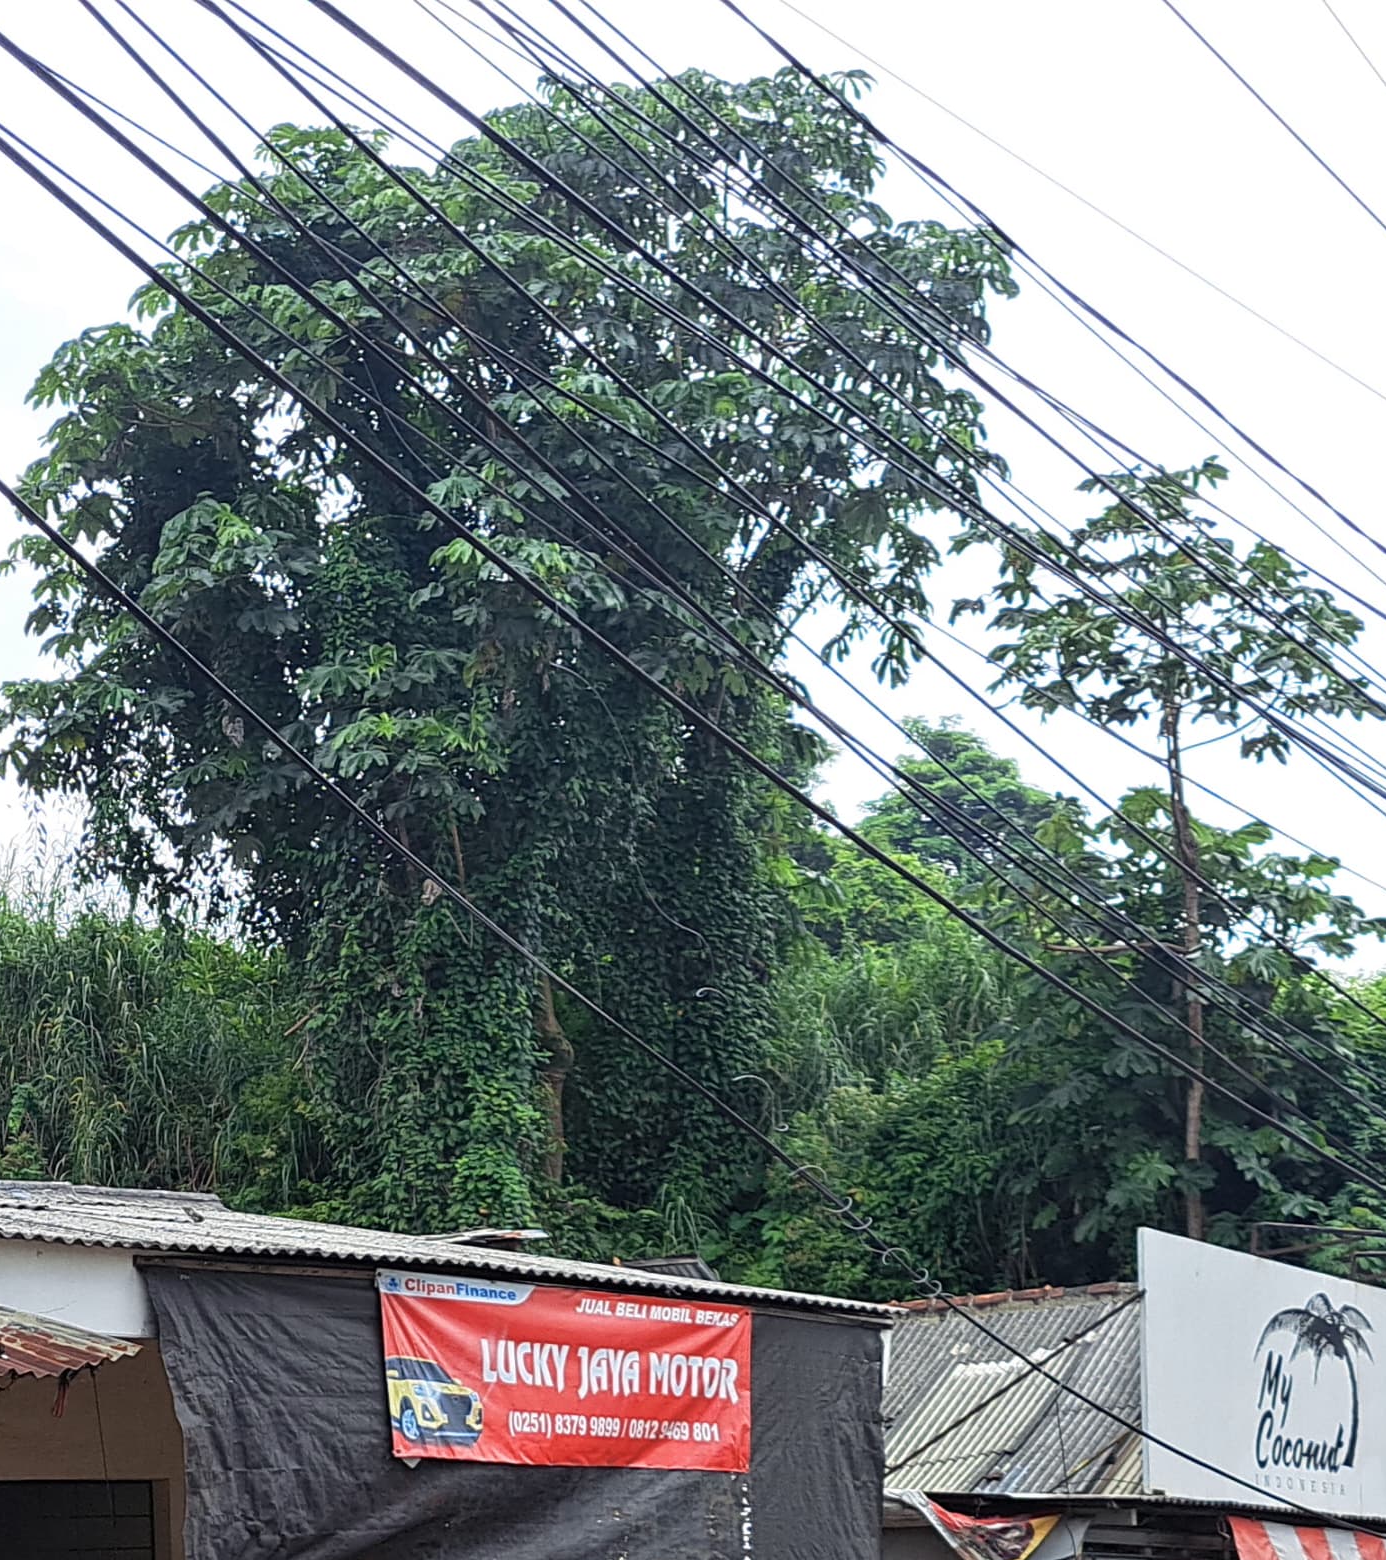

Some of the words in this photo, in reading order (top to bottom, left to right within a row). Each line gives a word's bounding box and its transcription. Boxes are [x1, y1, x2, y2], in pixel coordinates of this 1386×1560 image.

[404, 1278, 517, 1300] ClipanFinance
[575, 1298, 612, 1315] JUAL
[615, 1302, 647, 1319] BELI
[649, 1305, 693, 1324] MOBIL
[695, 1309, 740, 1328] BEKAS
[480, 1338, 570, 1394] LUCKY
[577, 1346, 640, 1400] JAYA
[649, 1352, 740, 1405] MOTOR
[1257, 1350, 1293, 1429] My
[508, 1411, 552, 1439] (0251)
[555, 1413, 587, 1436] 8379
[589, 1416, 621, 1438] 9899
[629, 1418, 659, 1439] 0812
[692, 1422, 720, 1442] 801
[1256, 1410, 1344, 1473] Coconut
[1254, 1473, 1346, 1496] INDONESIA
